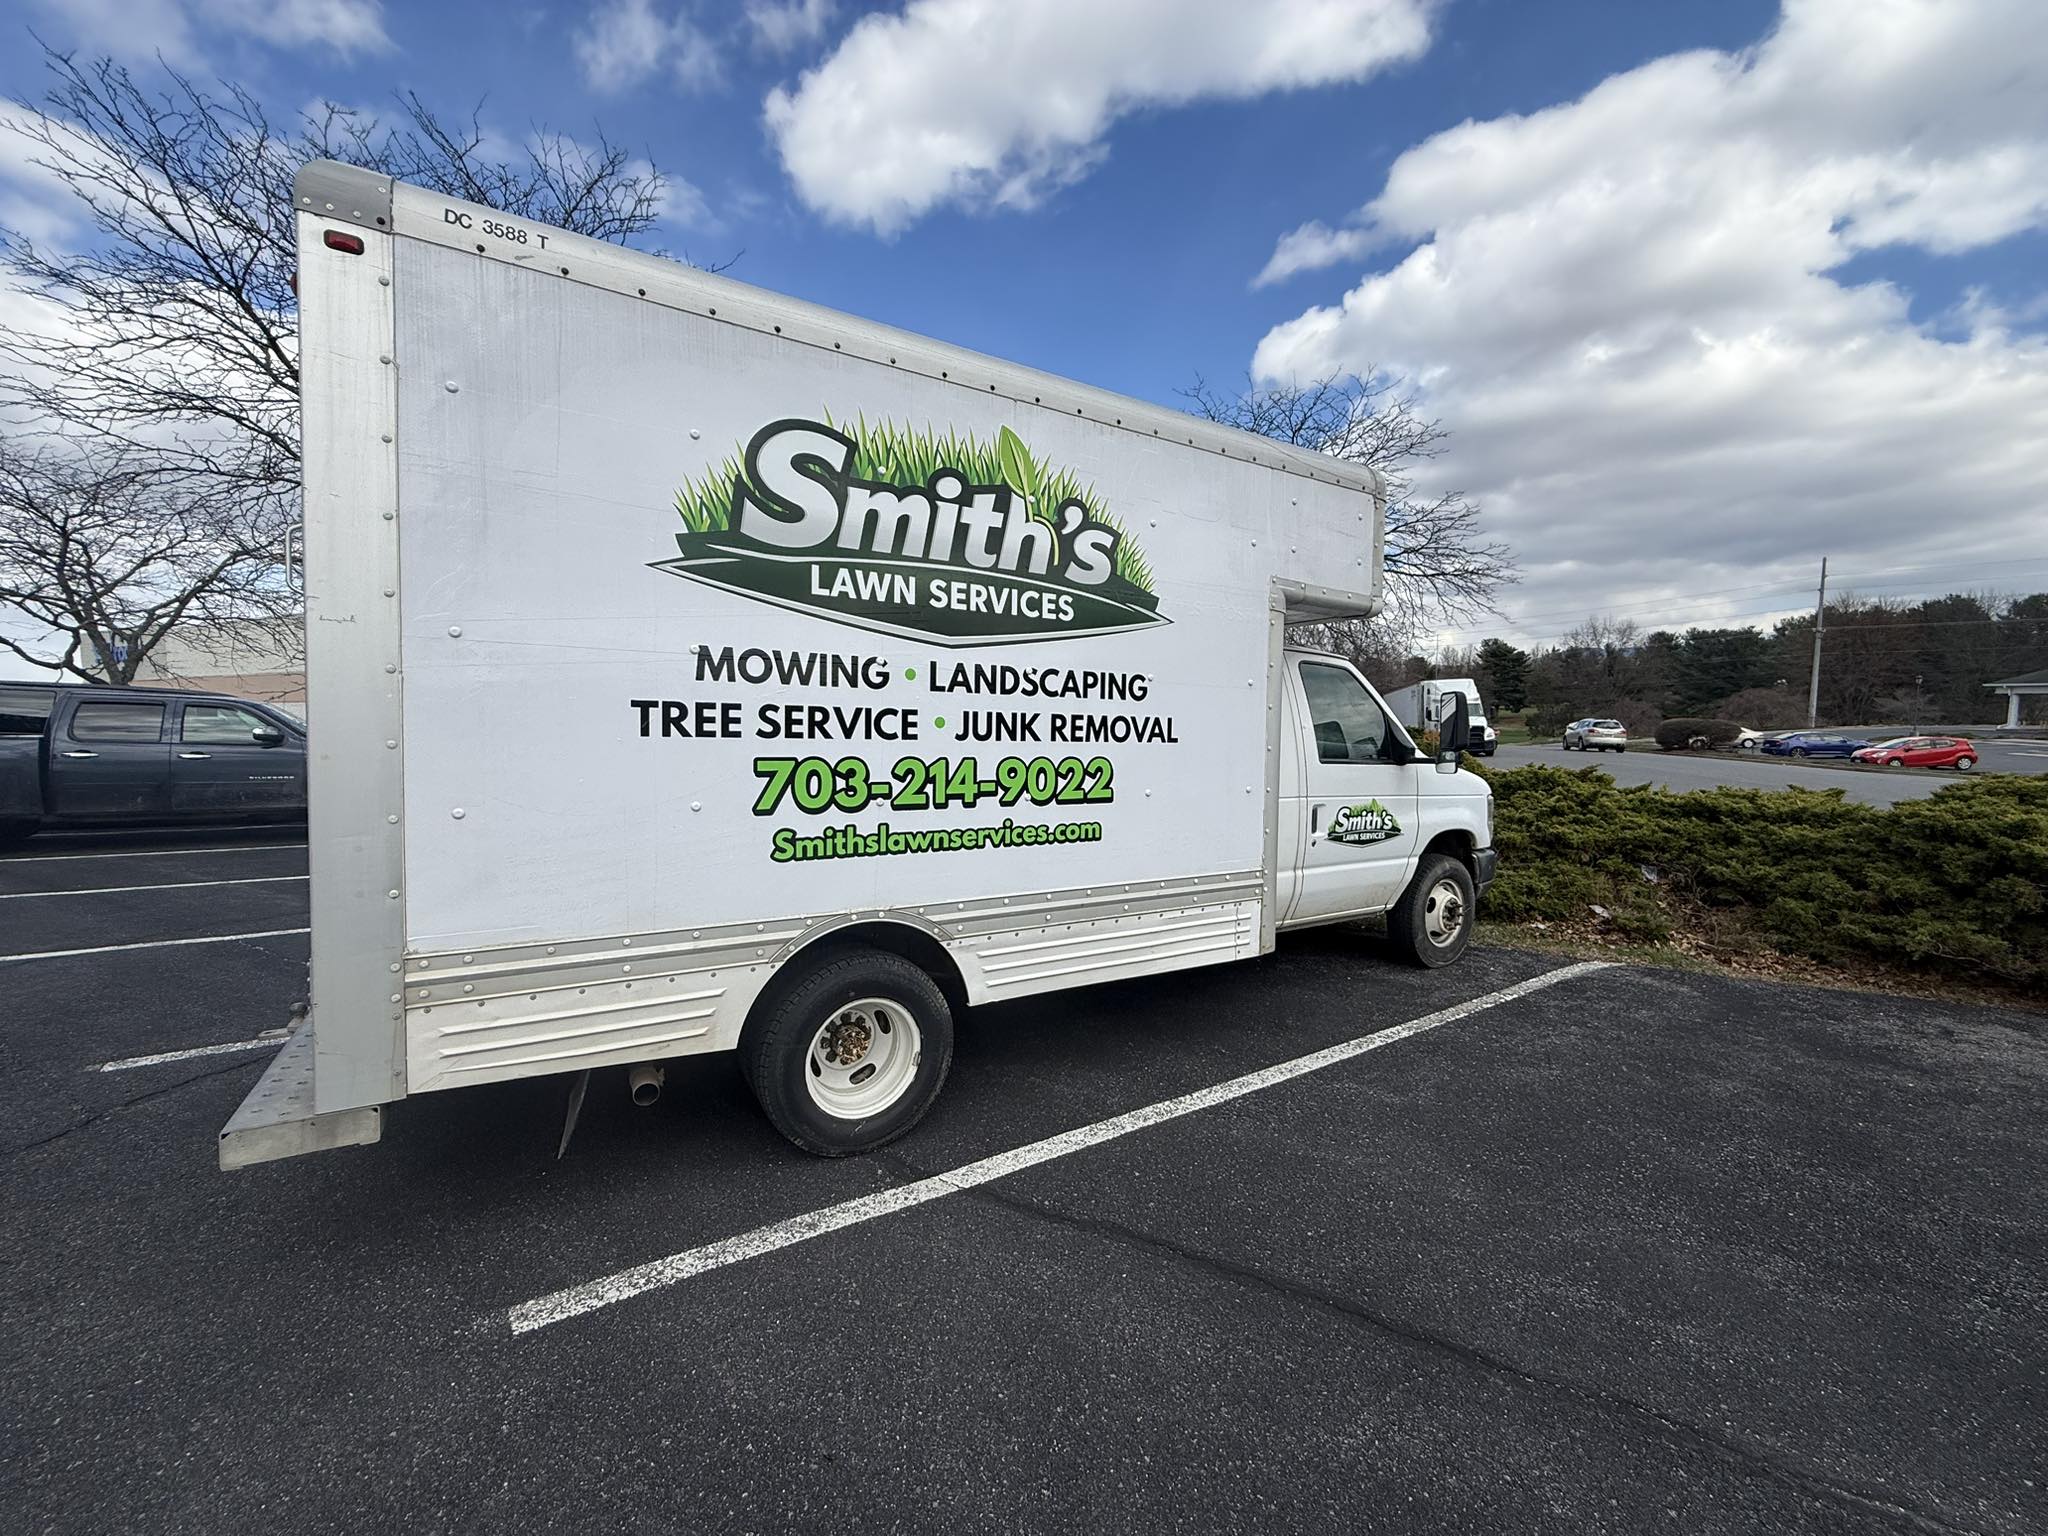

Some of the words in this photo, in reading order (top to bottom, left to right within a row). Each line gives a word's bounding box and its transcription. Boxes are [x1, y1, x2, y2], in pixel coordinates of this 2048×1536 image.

[444, 208, 473, 229] DC
[482, 219, 528, 245] 3588
[537, 234, 549, 249] T
[740, 429, 1115, 586] Smith's
[810, 564, 916, 604] LAWN
[929, 578, 1075, 622] SERVICES
[695, 644, 890, 690] MOWING
[929, 660, 1149, 702] LANDSCAPING
[630, 699, 743, 738] TREE
[755, 703, 919, 741] SERVICE
[954, 710, 1042, 742] JUNK
[1049, 713, 1179, 744] REMOVAL
[752, 755, 1114, 816] 703-214-9022
[770, 817, 1103, 863] Smithslawnservices.com
[1335, 807, 1393, 833] Smith's
